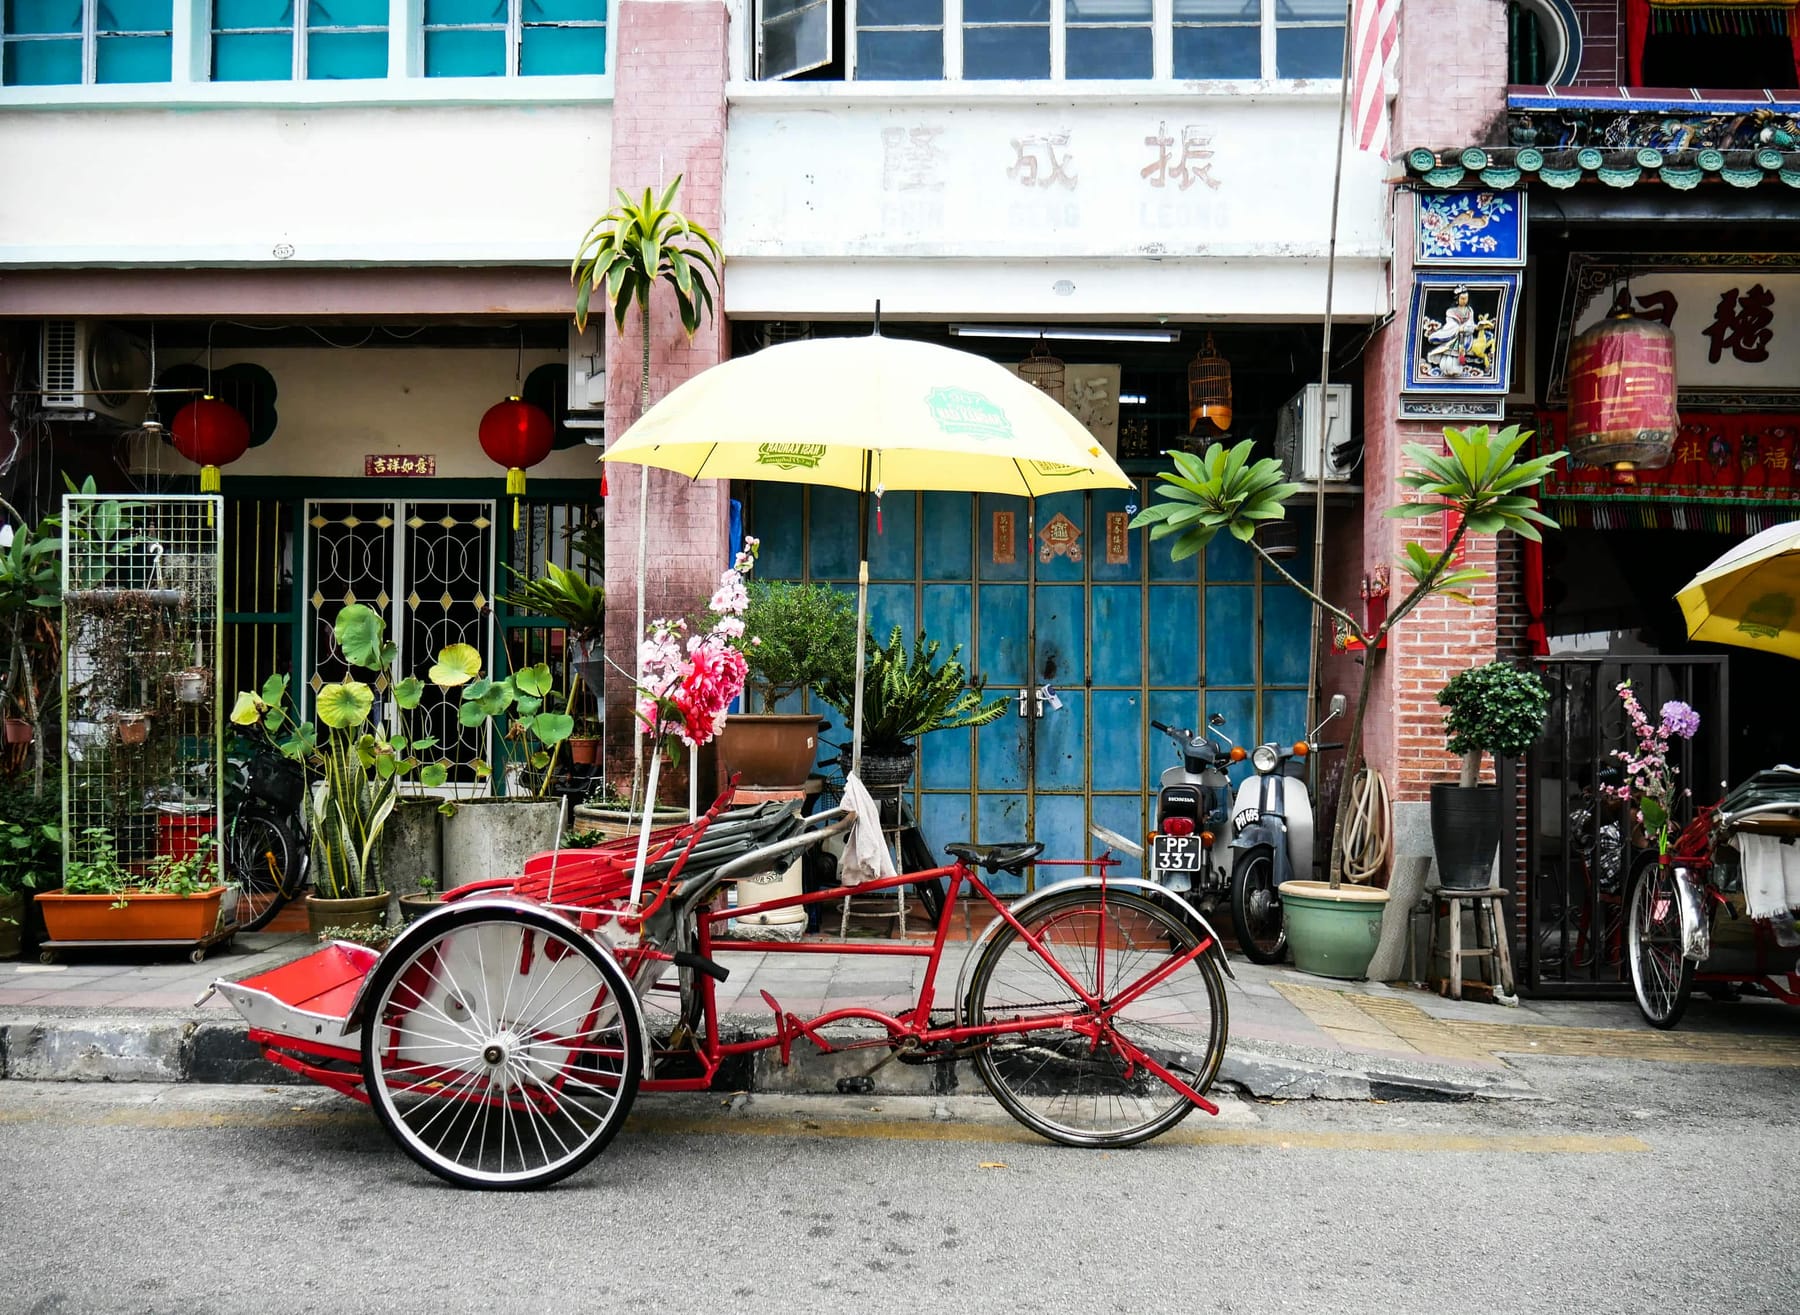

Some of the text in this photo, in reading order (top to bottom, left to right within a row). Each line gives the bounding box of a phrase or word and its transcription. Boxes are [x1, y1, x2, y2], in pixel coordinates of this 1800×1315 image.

[1140, 202, 1230, 229] LEONG
[373, 457, 428, 474] 吉祥如意
[1235, 811, 1247, 831] PH
[1166, 838, 1188, 852] PP
[1159, 853, 1196, 869] 337
